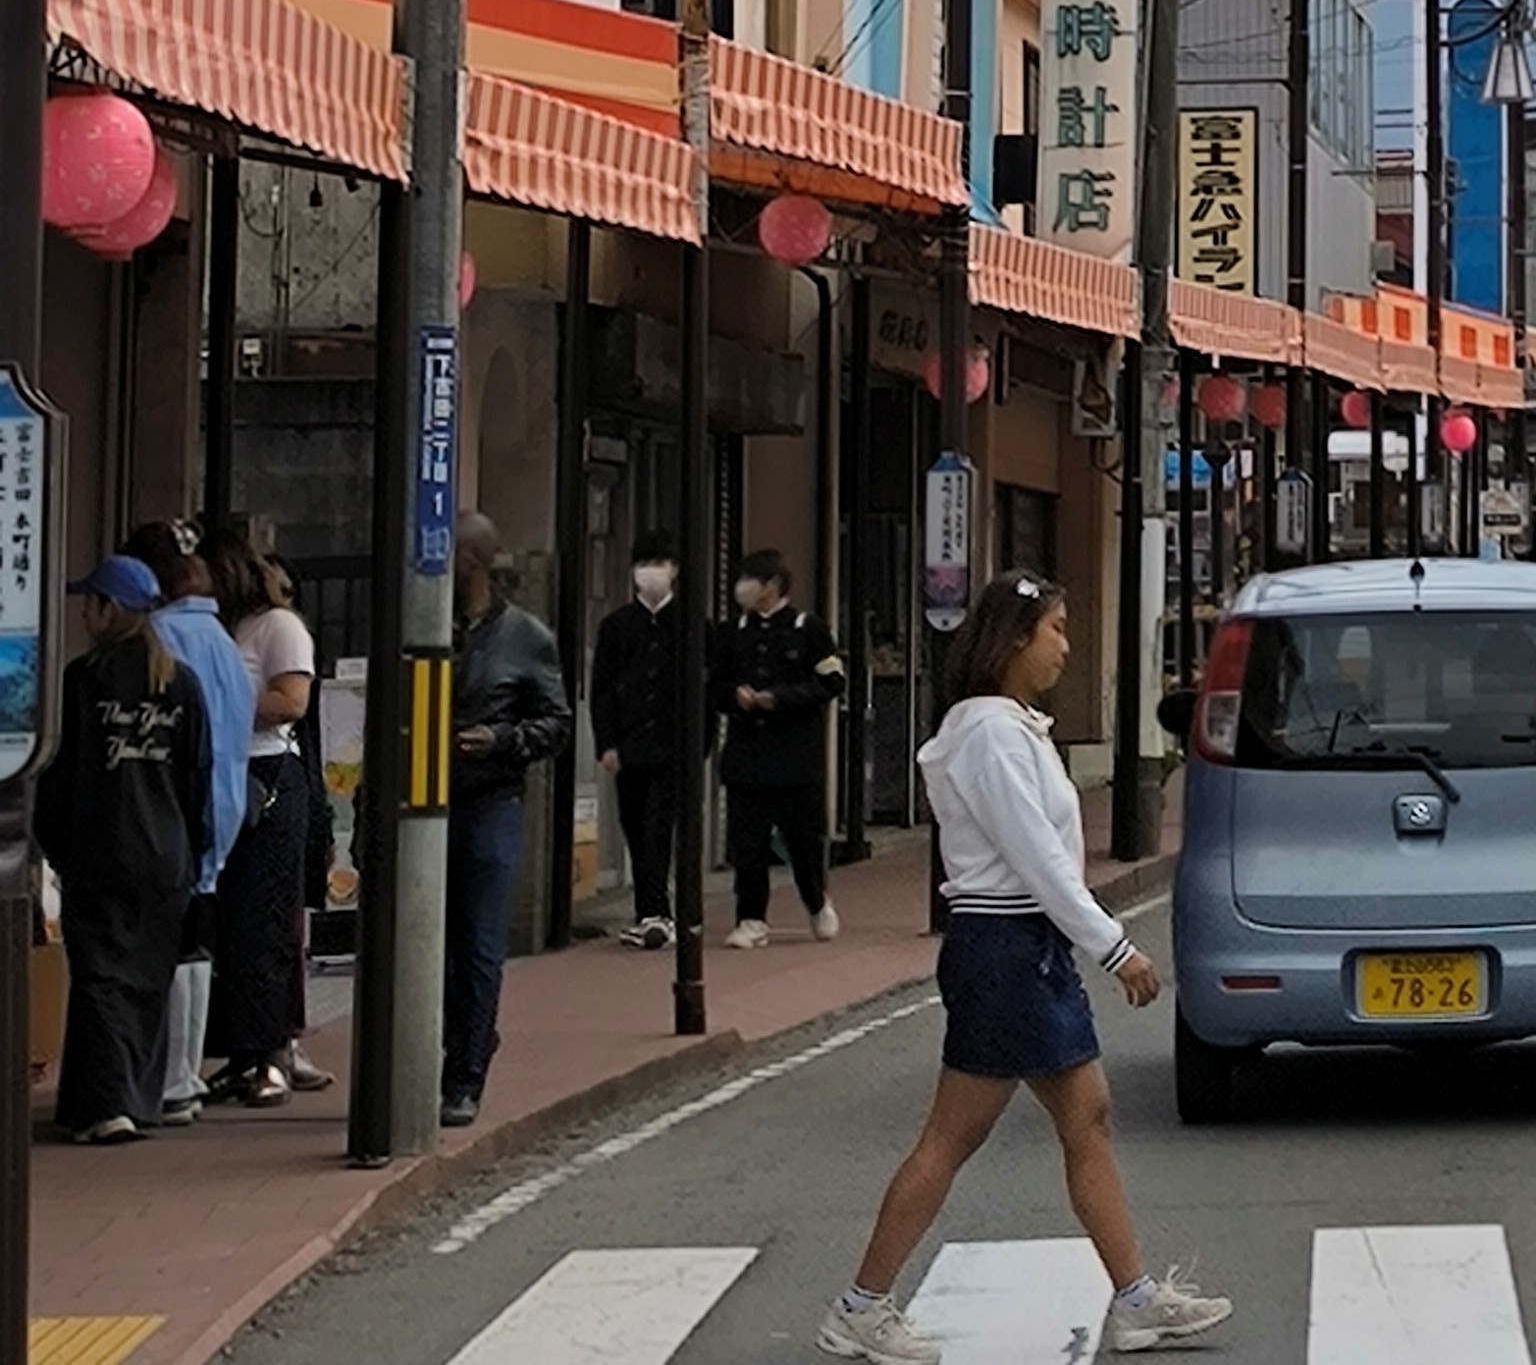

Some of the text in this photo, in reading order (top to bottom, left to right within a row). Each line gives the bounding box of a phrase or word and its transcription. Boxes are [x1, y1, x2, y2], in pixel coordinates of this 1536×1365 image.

[11, 422, 34, 591] 富士吉田 本町通り
